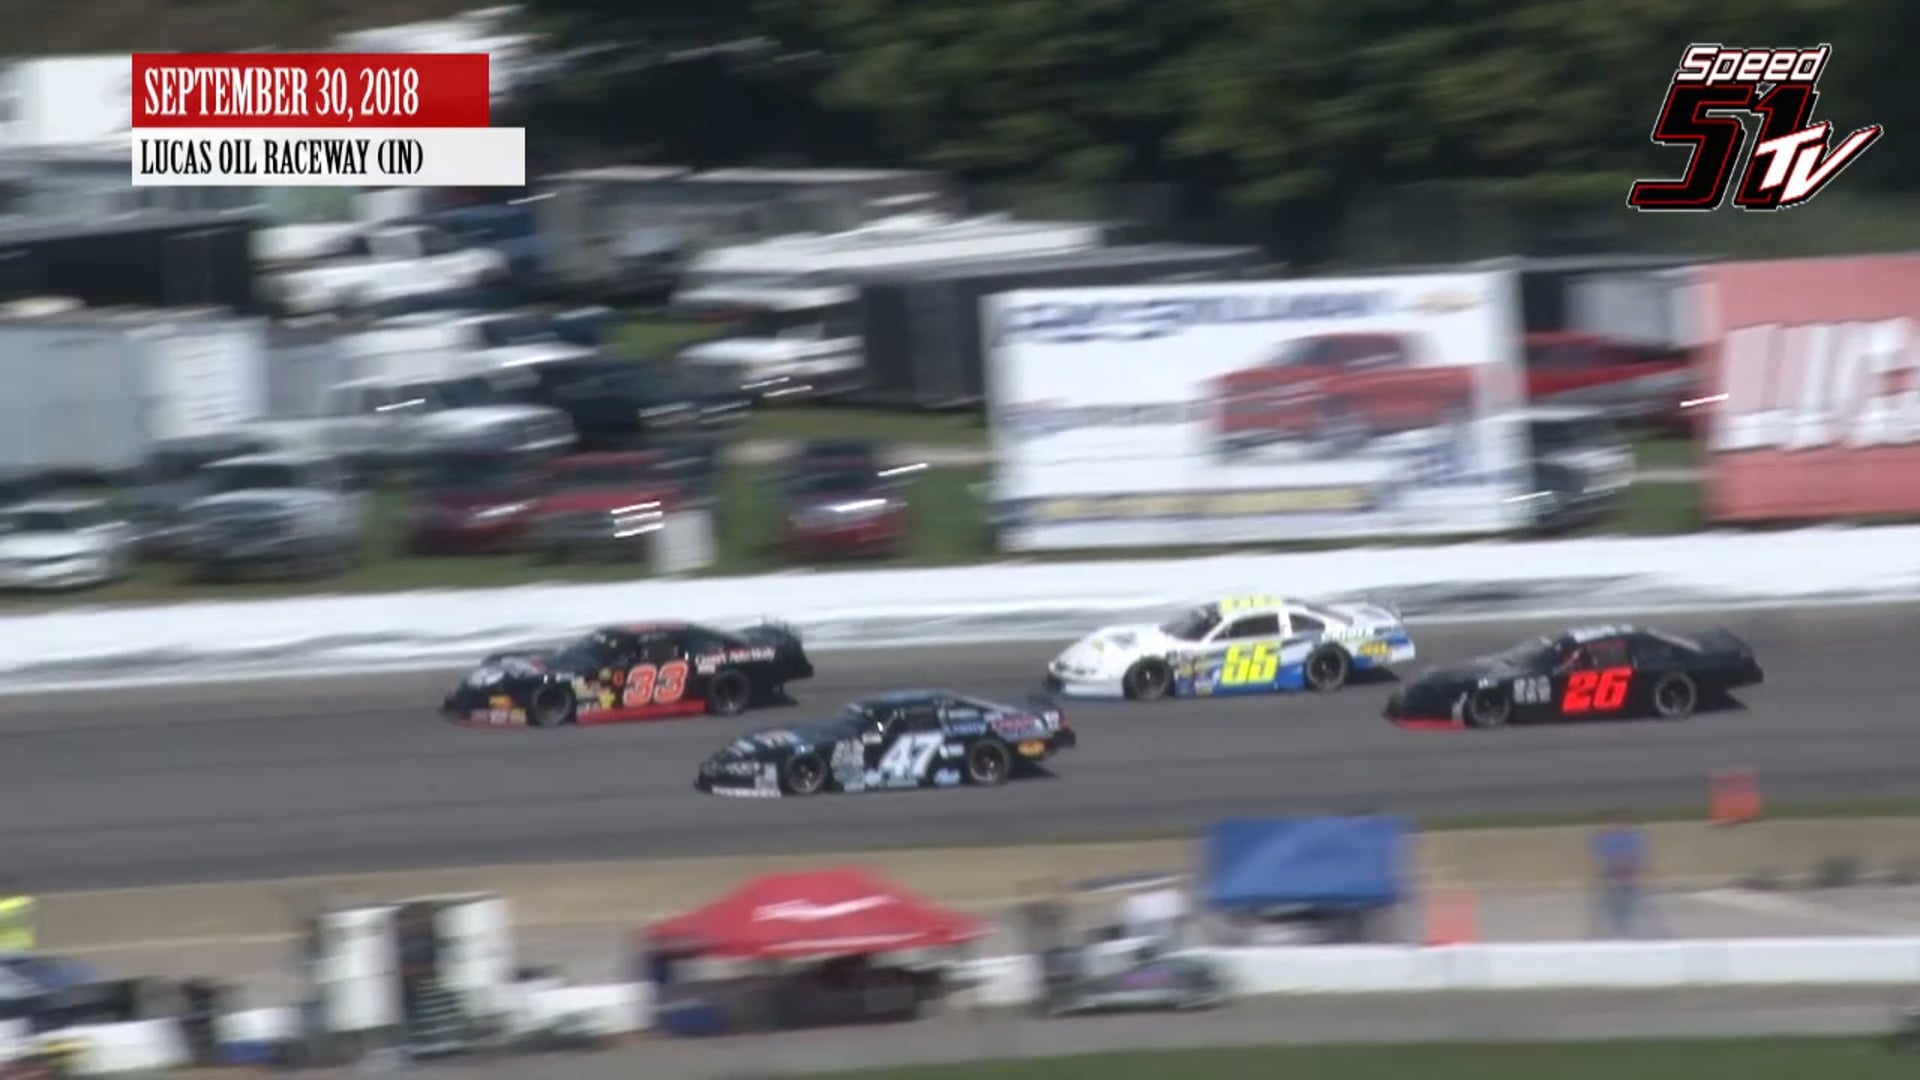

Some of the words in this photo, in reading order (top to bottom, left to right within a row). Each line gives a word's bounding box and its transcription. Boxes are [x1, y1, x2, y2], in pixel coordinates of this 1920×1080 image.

[621, 659, 690, 708] 33
[1220, 640, 1281, 688] 55
[1561, 665, 1634, 714] 26
[879, 730, 945, 779] 47
